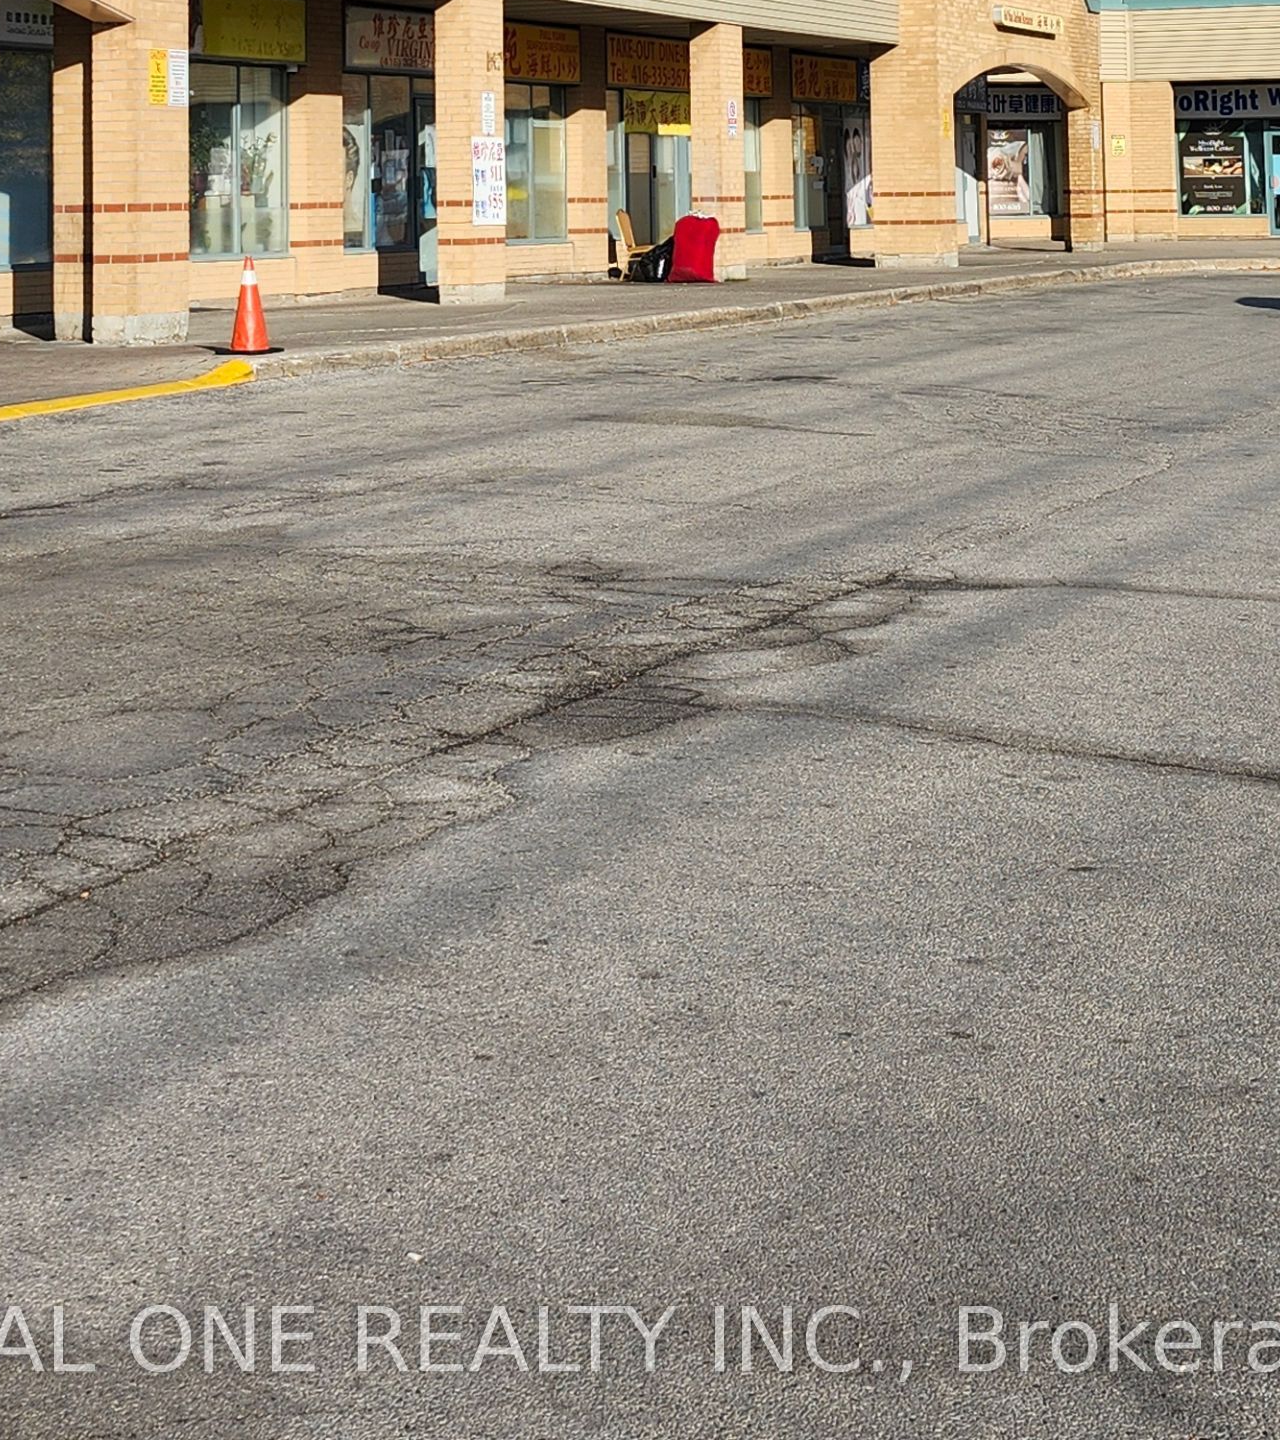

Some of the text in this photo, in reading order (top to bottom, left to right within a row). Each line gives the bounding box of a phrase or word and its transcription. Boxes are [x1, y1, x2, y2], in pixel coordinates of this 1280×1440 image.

[609, 37, 654, 60] TAKE-OUT
[986, 94, 1061, 114] 叶草健康
[1175, 89, 1259, 115] oRight
